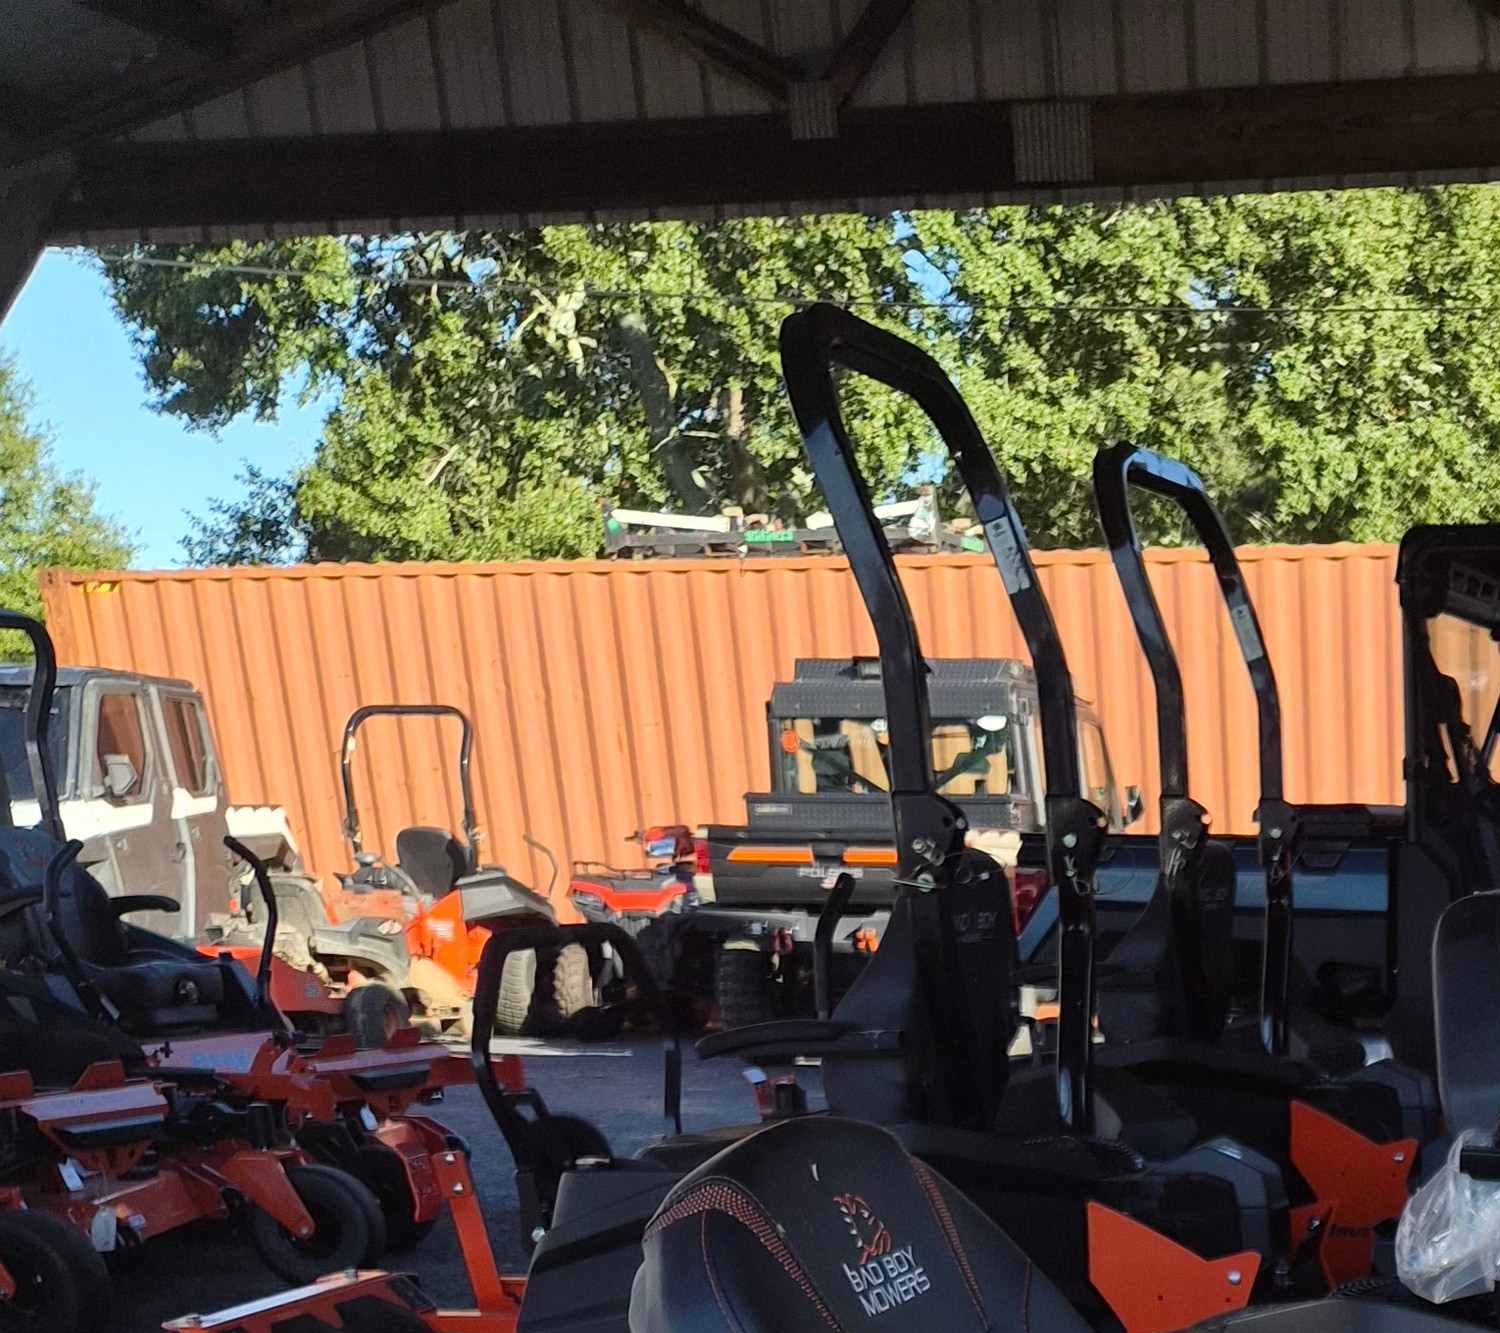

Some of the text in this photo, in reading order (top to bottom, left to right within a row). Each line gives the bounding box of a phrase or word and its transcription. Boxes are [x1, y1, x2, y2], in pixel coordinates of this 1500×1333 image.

[842, 1245, 917, 1293] BAD BOY
[858, 1267, 931, 1317] MOWERS
